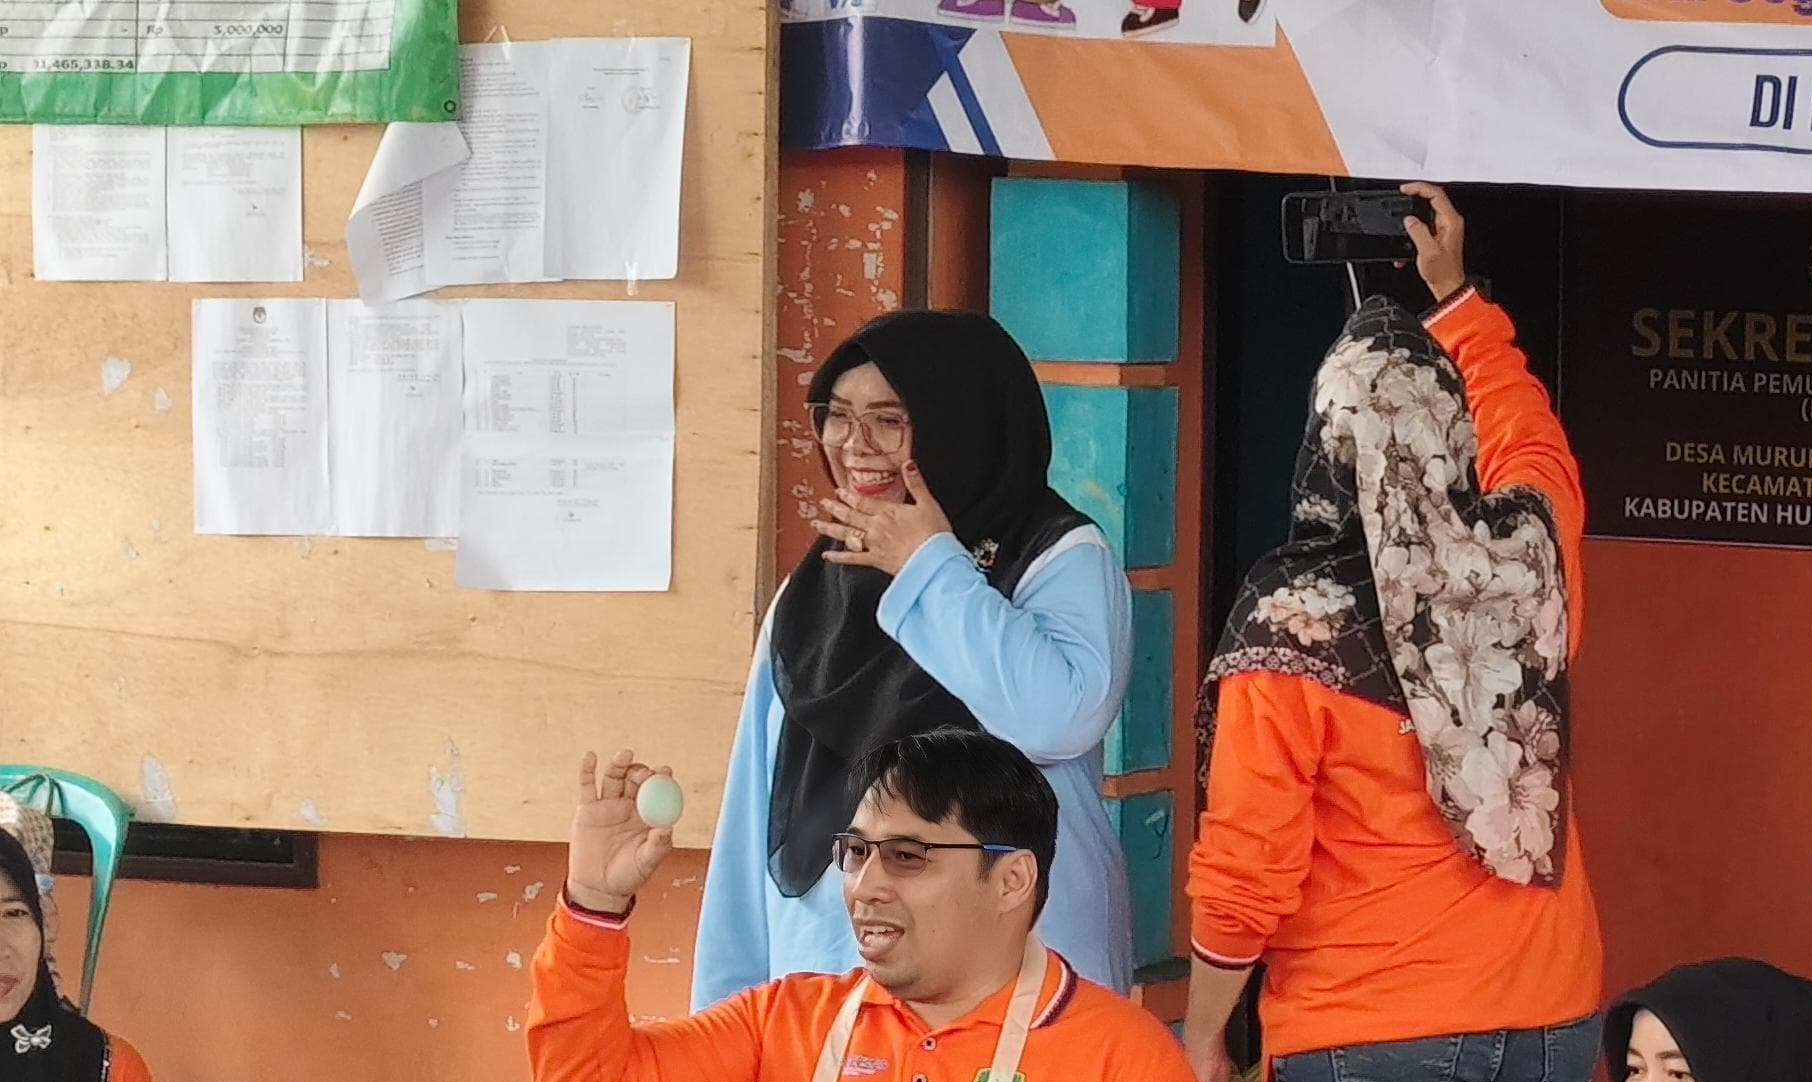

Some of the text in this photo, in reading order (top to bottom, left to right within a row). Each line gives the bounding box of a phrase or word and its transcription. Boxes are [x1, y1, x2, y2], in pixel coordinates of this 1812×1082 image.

[1749, 74, 1798, 131] DI
[1649, 368, 1747, 393] PANITIA
[1665, 441, 1724, 466] DESA
[1624, 497, 1769, 524] KABUPATEN
